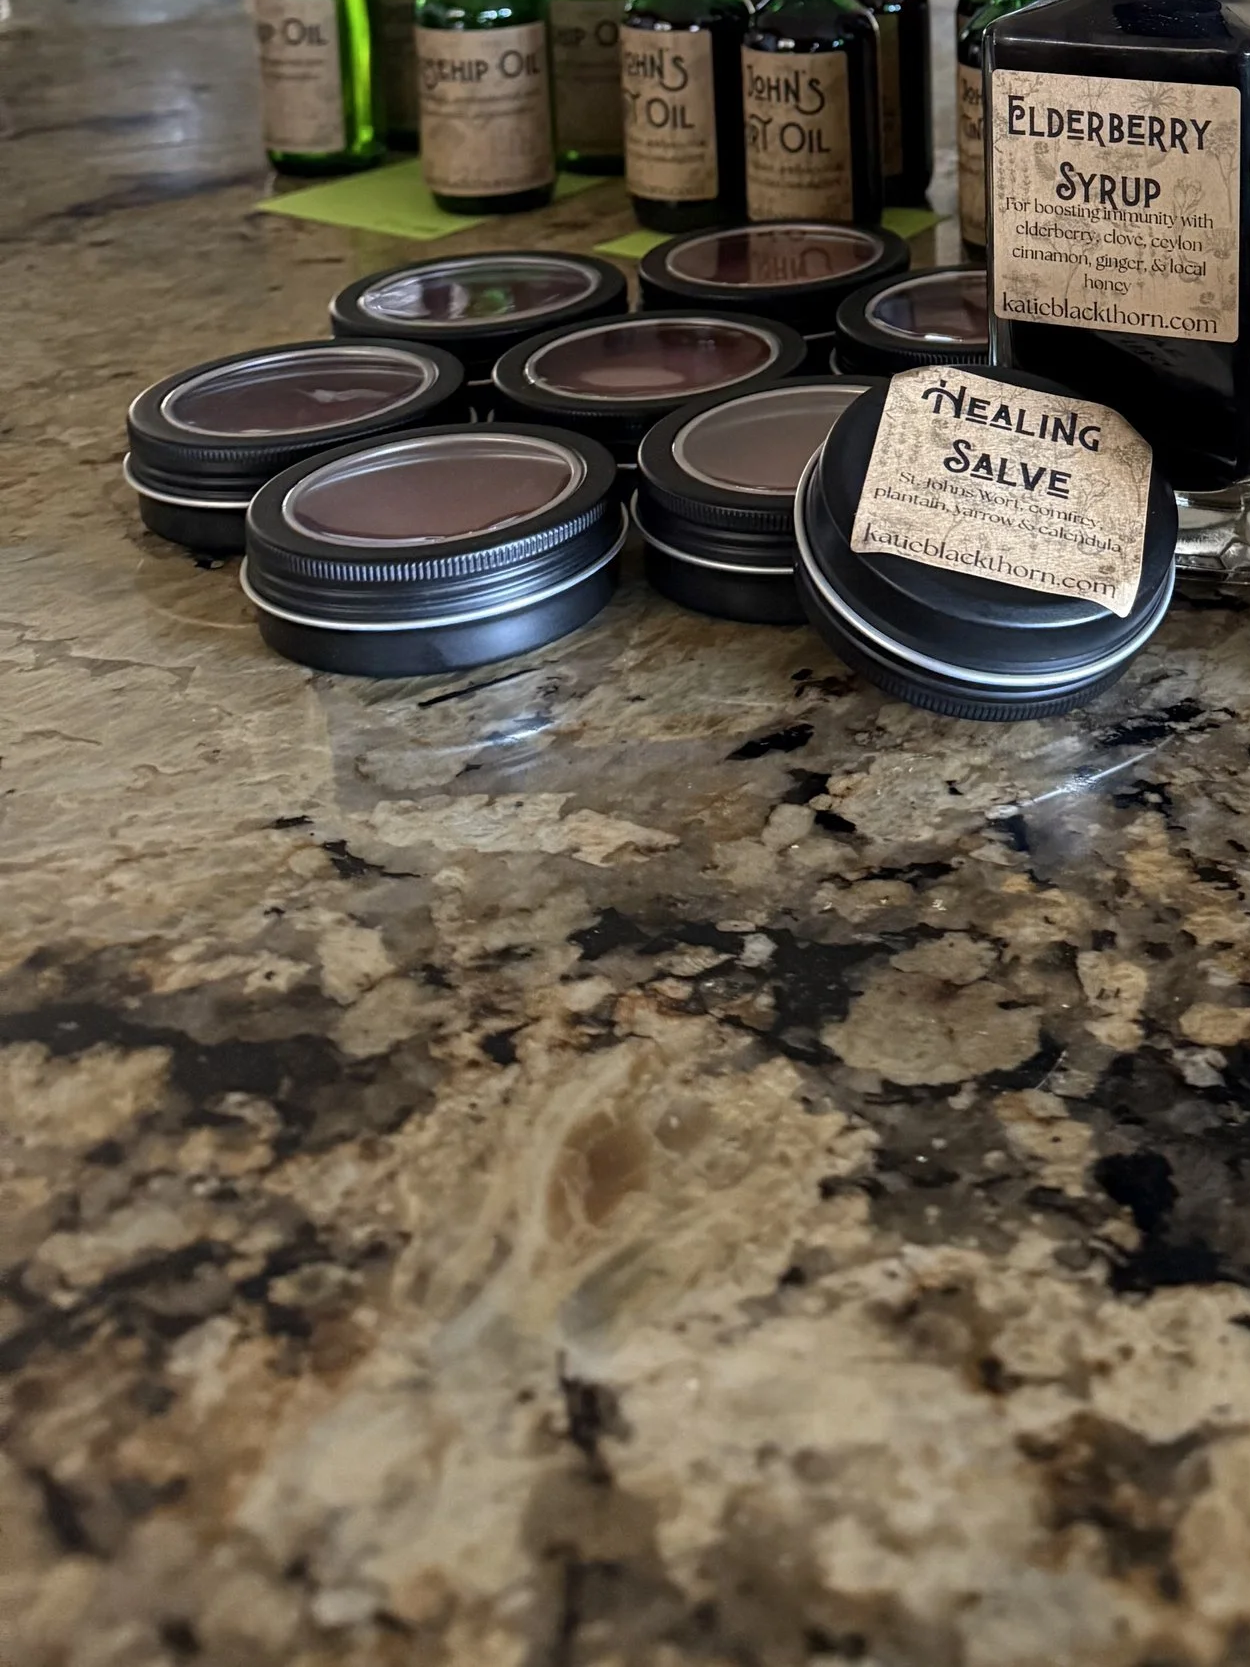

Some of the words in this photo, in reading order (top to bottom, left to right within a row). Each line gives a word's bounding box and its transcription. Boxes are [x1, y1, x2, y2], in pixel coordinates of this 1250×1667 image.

[500, 49, 541, 79] OIL
[646, 97, 696, 130] OIL
[1008, 95, 1212, 154] ELDERBERRY
[780, 122, 831, 153] OIL
[1056, 161, 1161, 210] SYRUP
[1005, 196, 1030, 213] For
[1034, 199, 1101, 221] boosting
[1103, 206, 1177, 229] immunity
[1176, 213, 1214, 230] with
[1015, 222, 1100, 243] elderberry,
[1104, 230, 1147, 248] clove,
[1151, 232, 1203, 253] ceylon
[1012, 245, 1092, 267] cinnamon,
[1095, 254, 1148, 274] ginger,
[1151, 258, 1170, 273] &
[1170, 258, 1207, 276] local
[1084, 274, 1133, 296] honey
[1002, 291, 1218, 334] katieblackthorn.com
[921, 380, 1102, 452] HEALING
[943, 439, 1073, 500] SALVE
[874, 486, 950, 514] plantain,
[950, 506, 1016, 528] yarrow
[1017, 518, 1036, 532] &
[1038, 522, 1122, 555] calendula
[925, 476, 975, 499] Johns
[978, 485, 1024, 512] Wort,
[1029, 503, 1104, 532] comfrey,
[863, 522, 1118, 600] katieblackthorn.com
